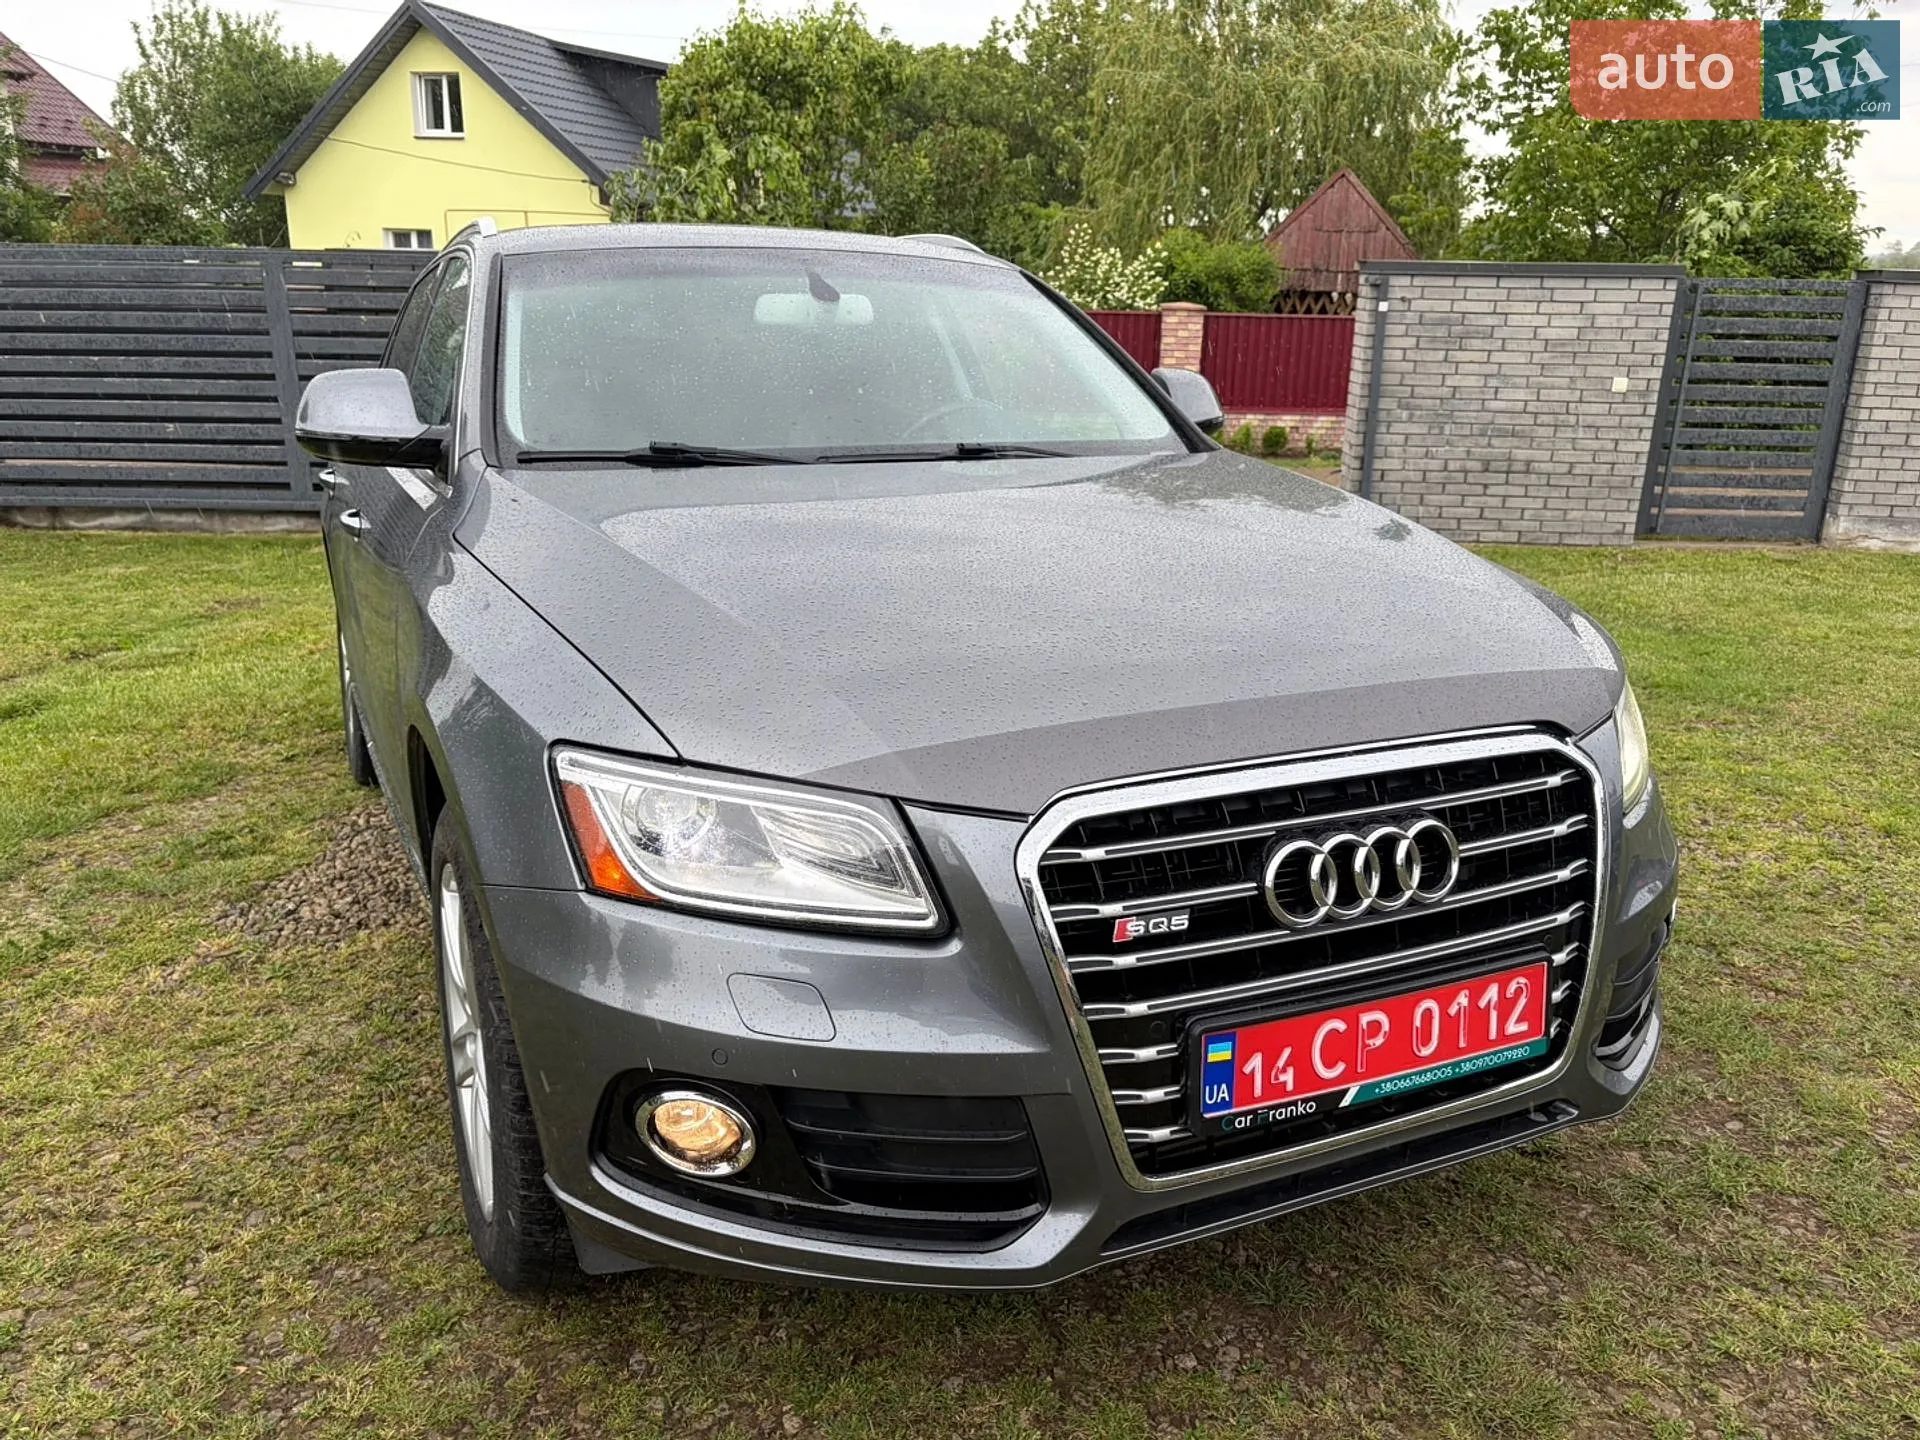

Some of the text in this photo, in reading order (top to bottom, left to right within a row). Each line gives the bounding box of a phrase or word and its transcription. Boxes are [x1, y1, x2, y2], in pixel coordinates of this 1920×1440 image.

[1126, 914, 1189, 936] SQ5
[1241, 976, 1530, 1098] 14 CP 0112
[1205, 1083, 1230, 1105] UA
[1221, 1100, 1316, 1131] Car Franko
